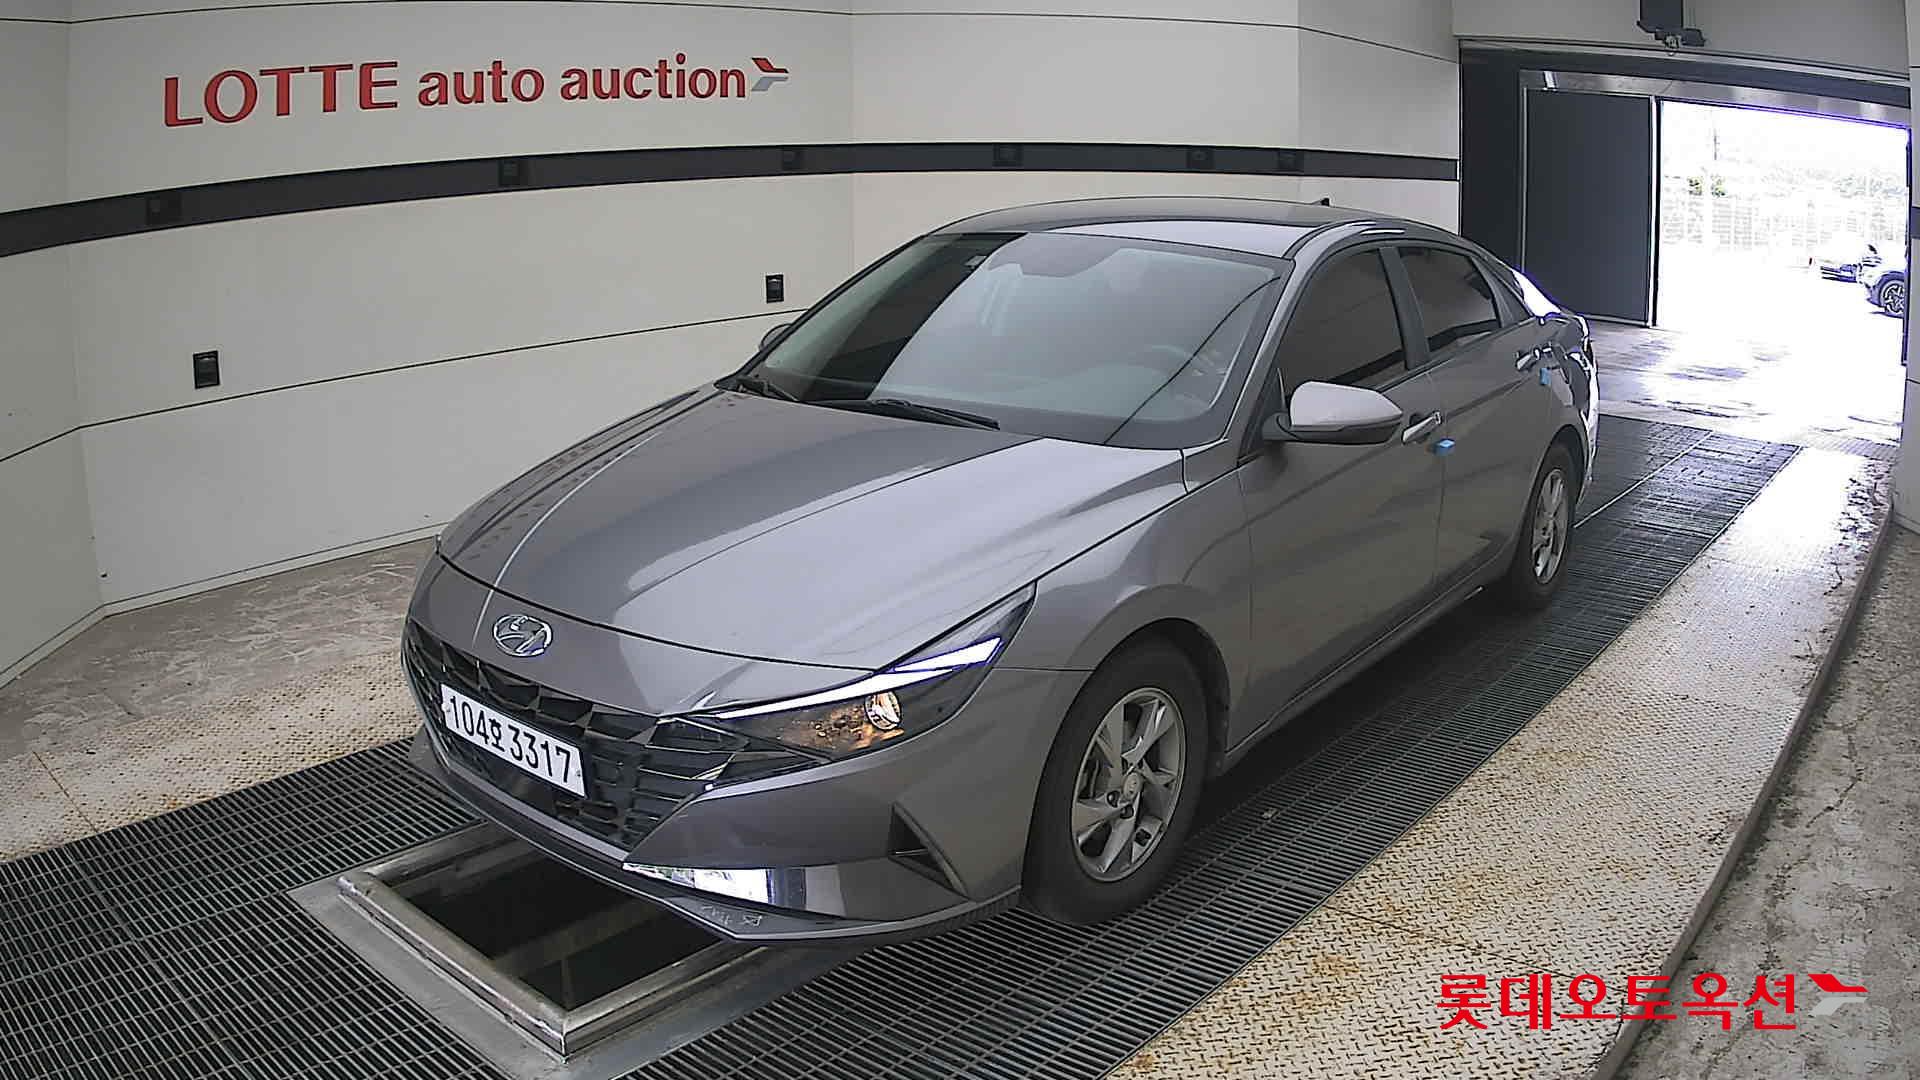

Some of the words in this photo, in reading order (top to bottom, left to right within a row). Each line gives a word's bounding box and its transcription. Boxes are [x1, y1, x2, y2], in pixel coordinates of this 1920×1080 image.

[164, 60, 398, 127] LOTTE
[418, 60, 545, 106] auto
[560, 53, 747, 100] auction
[450, 695, 505, 752] 104호
[508, 724, 571, 783] 3317
